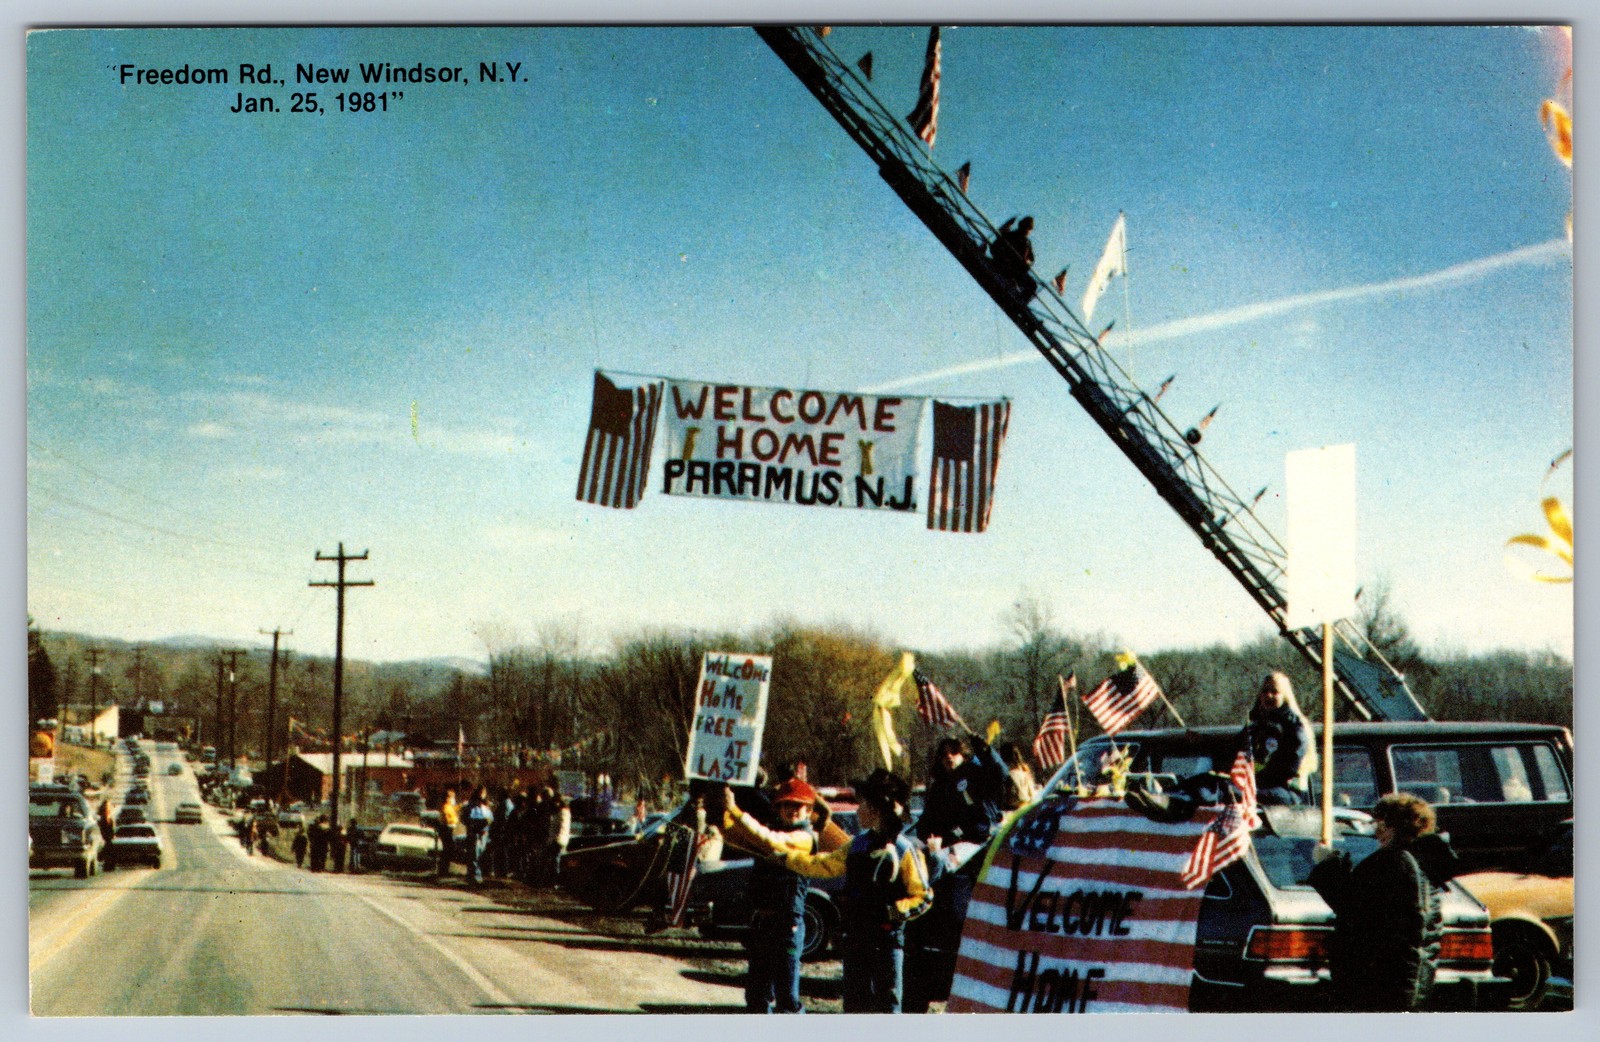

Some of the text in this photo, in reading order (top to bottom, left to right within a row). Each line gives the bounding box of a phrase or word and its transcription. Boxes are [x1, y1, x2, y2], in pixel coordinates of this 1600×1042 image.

[671, 384, 900, 432] WELCOME
[716, 427, 844, 466] HOME
[696, 715, 736, 737] FREE
[725, 740, 748, 760] AT
[697, 753, 748, 780] LAST
